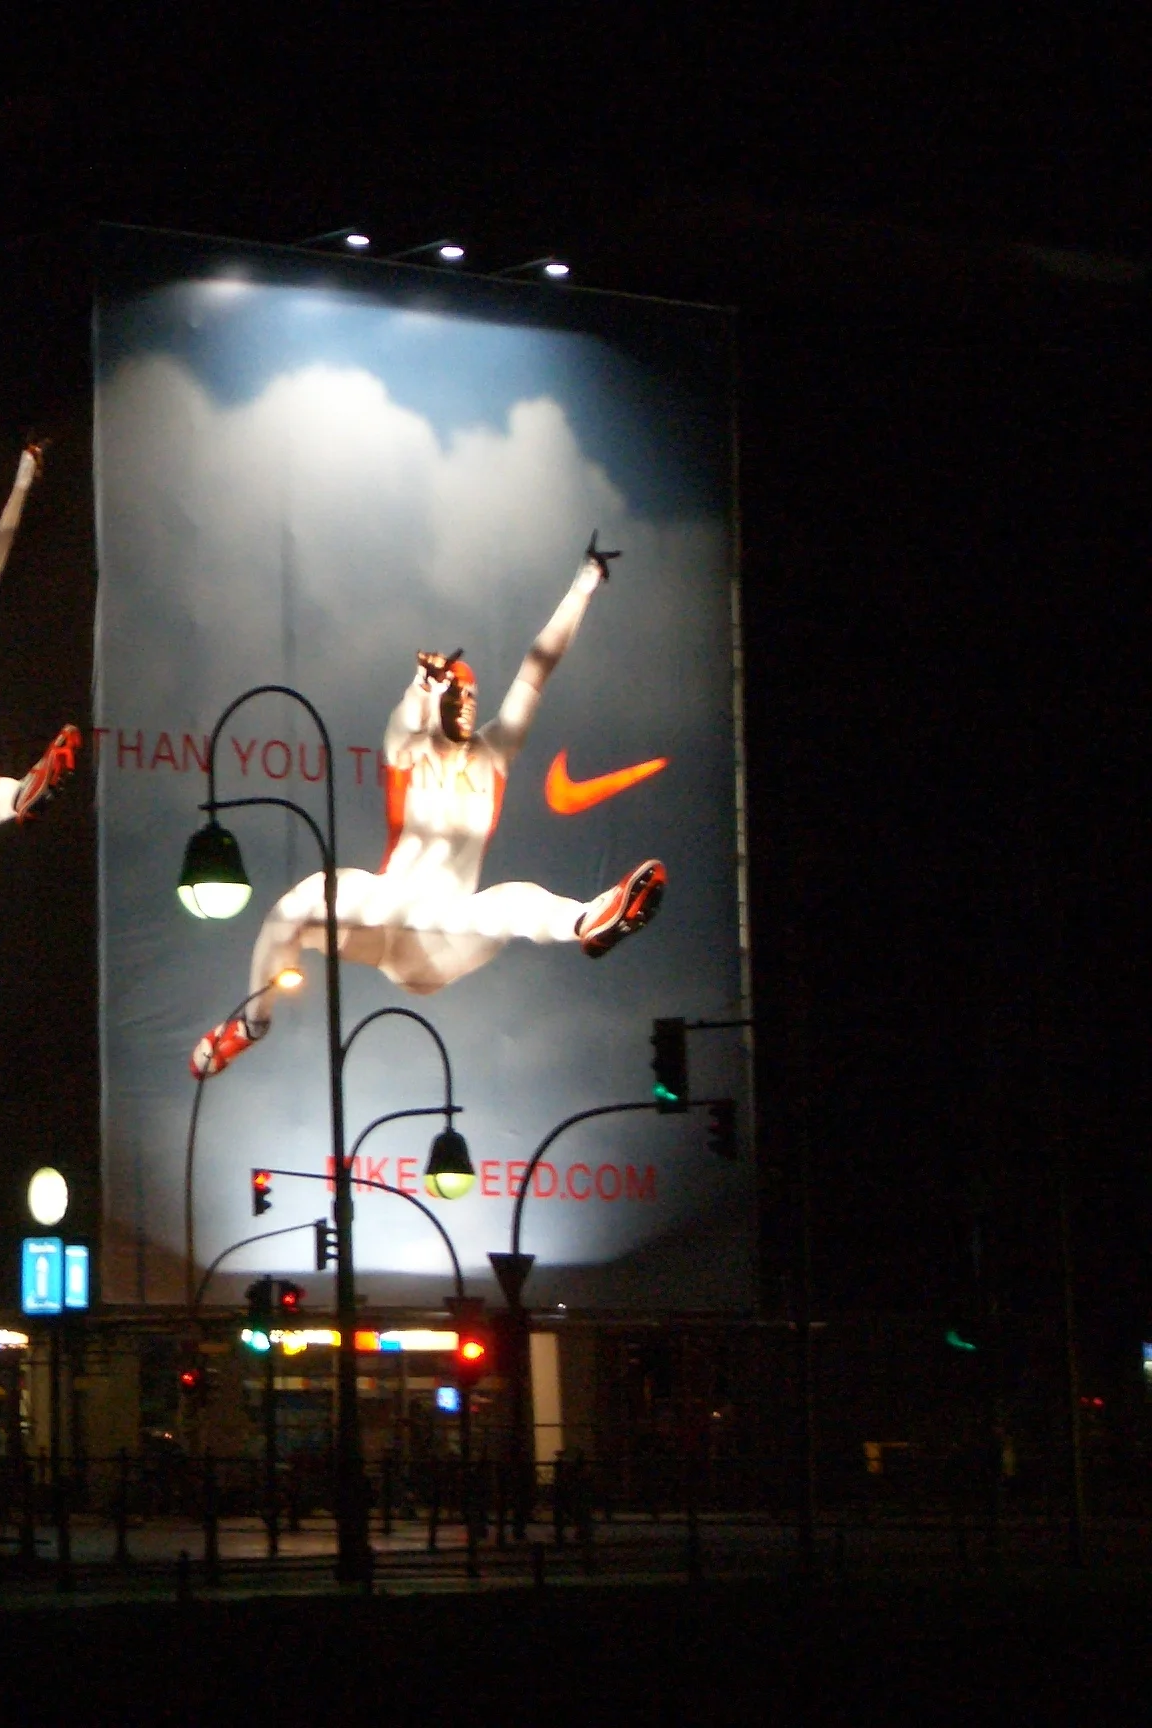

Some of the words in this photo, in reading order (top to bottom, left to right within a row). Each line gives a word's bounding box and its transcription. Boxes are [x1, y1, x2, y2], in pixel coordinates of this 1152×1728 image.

[90, 727, 211, 774] THAN
[231, 736, 327, 783] YOU
[325, 1154, 658, 1204] NIKEEED.COM
